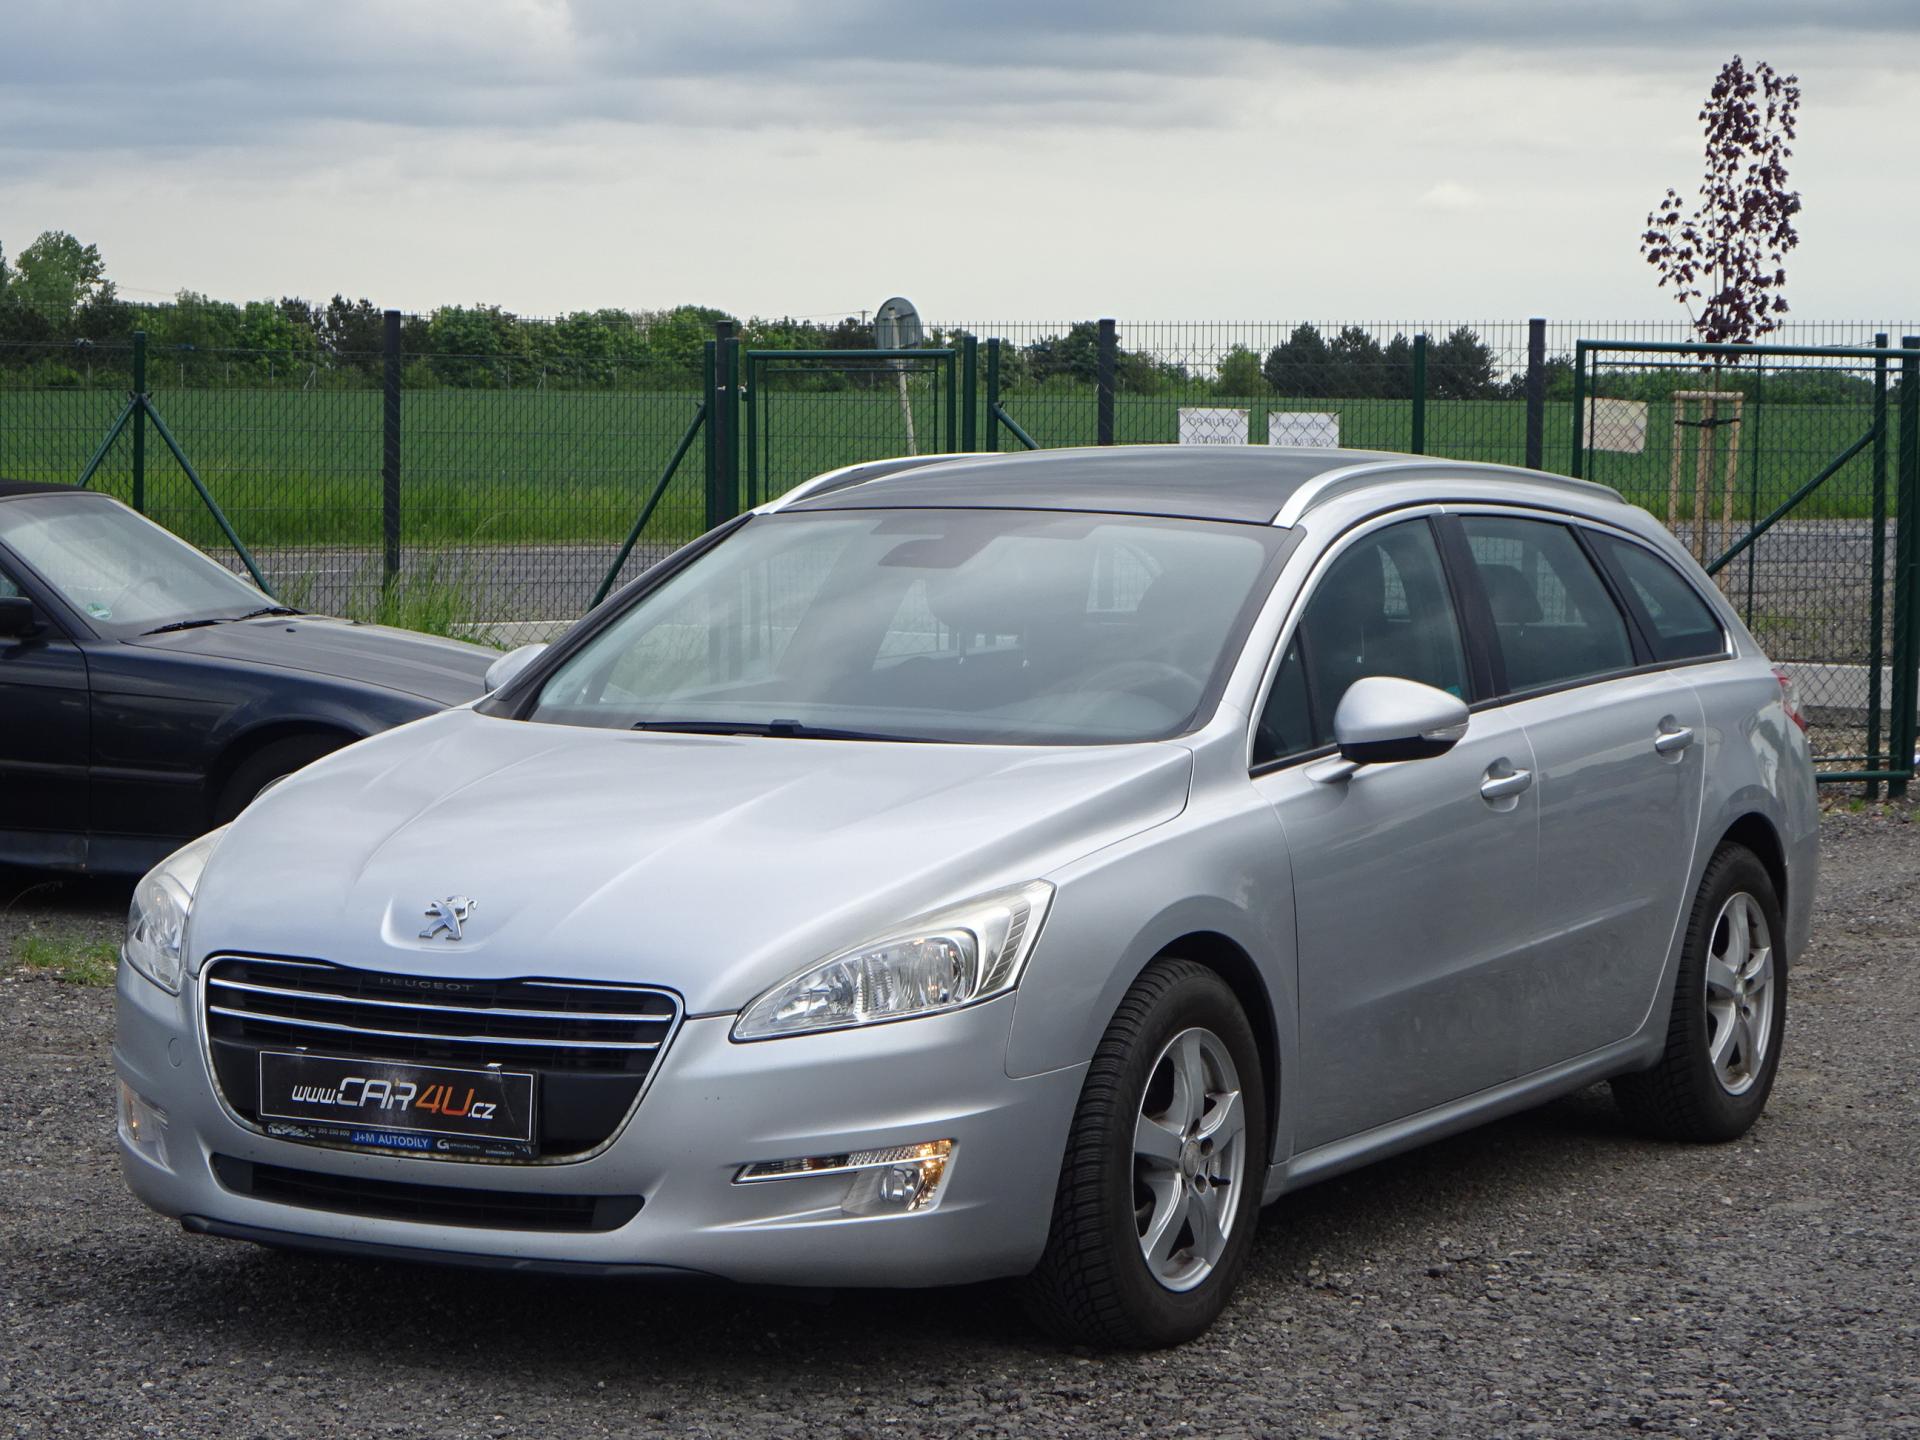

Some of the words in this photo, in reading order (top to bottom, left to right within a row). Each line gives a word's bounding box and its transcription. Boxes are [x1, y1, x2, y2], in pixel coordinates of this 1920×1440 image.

[380, 977, 474, 991] PEUGEOT
[292, 1077, 497, 1120] www.CAR4U.cz
[354, 1132, 376, 1144] J+M
